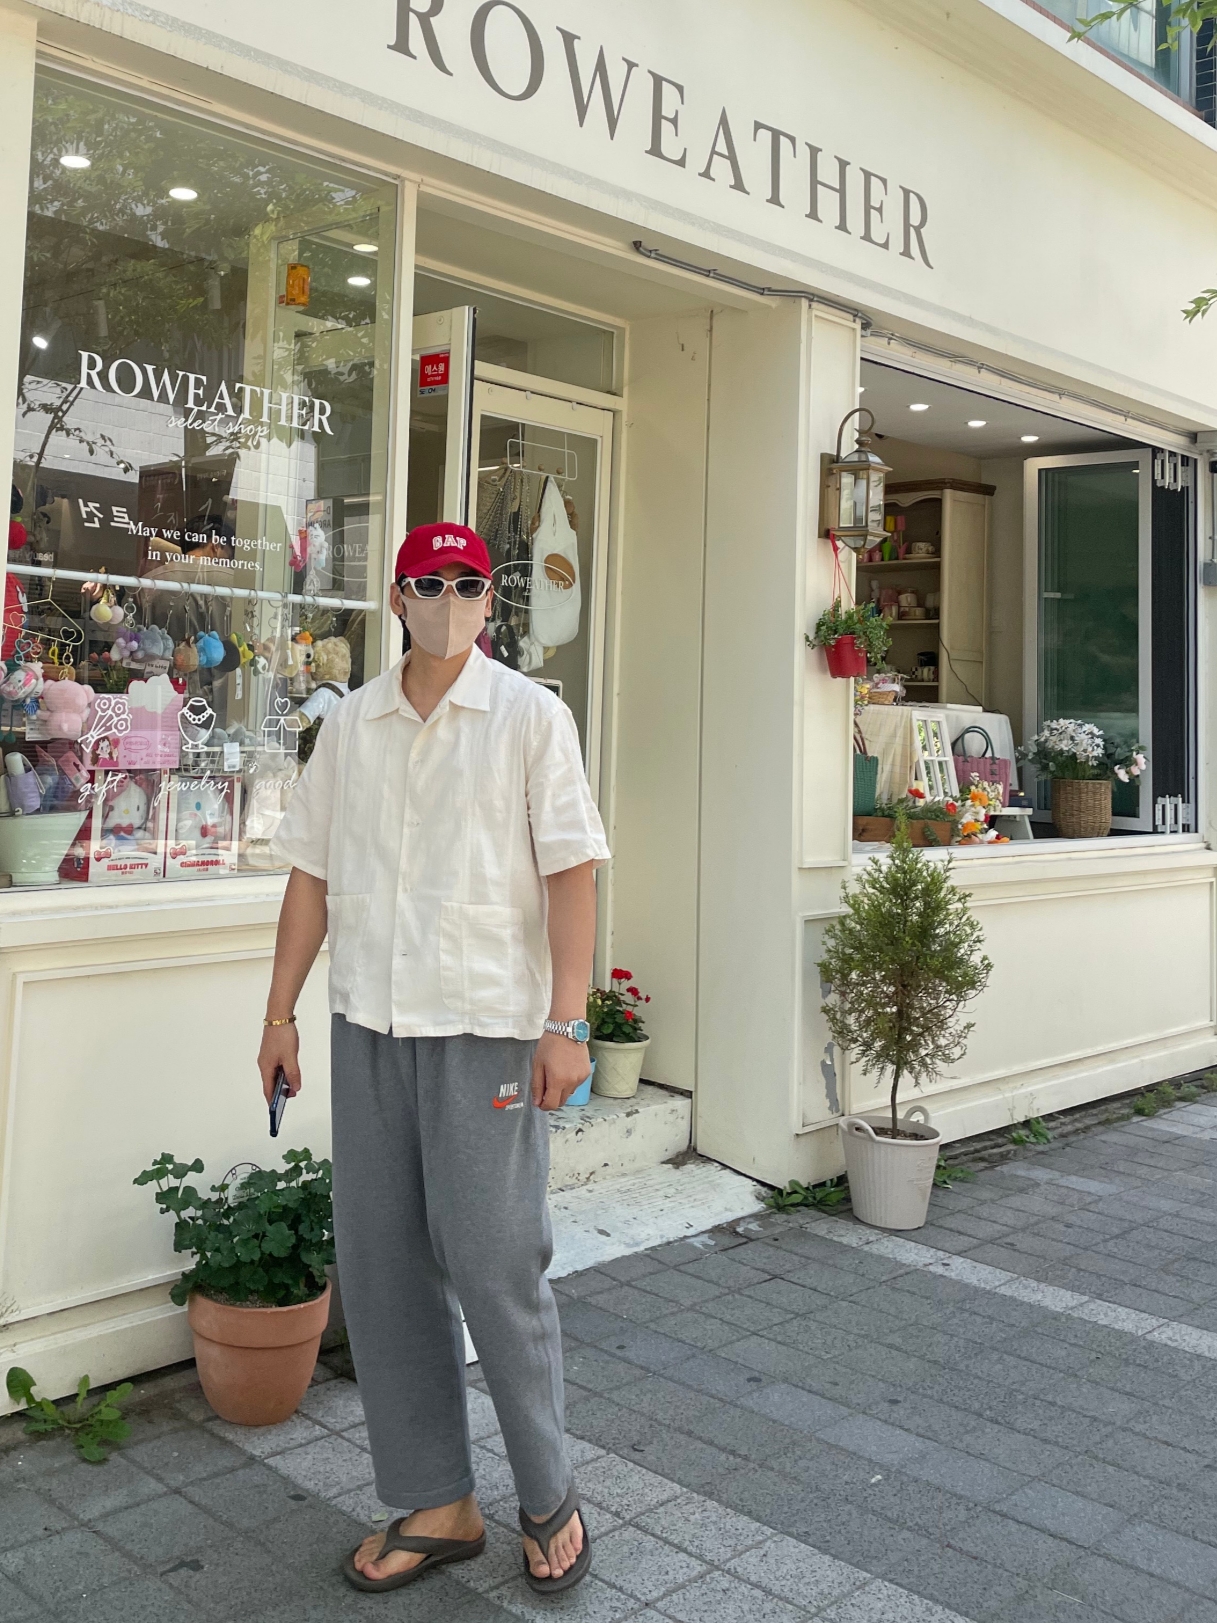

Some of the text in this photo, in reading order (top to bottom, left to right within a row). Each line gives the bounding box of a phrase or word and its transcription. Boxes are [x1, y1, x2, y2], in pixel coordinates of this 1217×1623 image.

[387, 0, 934, 270] ROWEATHER
[424, 362, 445, 376] 에스원
[77, 349, 335, 436] ROWEATHER
[166, 409, 270, 442] select shop
[128, 520, 283, 553] May we can be together
[432, 534, 467, 551] GAP
[148, 546, 264, 572] in your memories.
[501, 574, 564, 593] ROWEATHER
[78, 771, 126, 805] gift
[154, 771, 231, 807] jewelry
[107, 862, 149, 871] HELLO KITTY
[499, 1082, 519, 1098] NIKE
